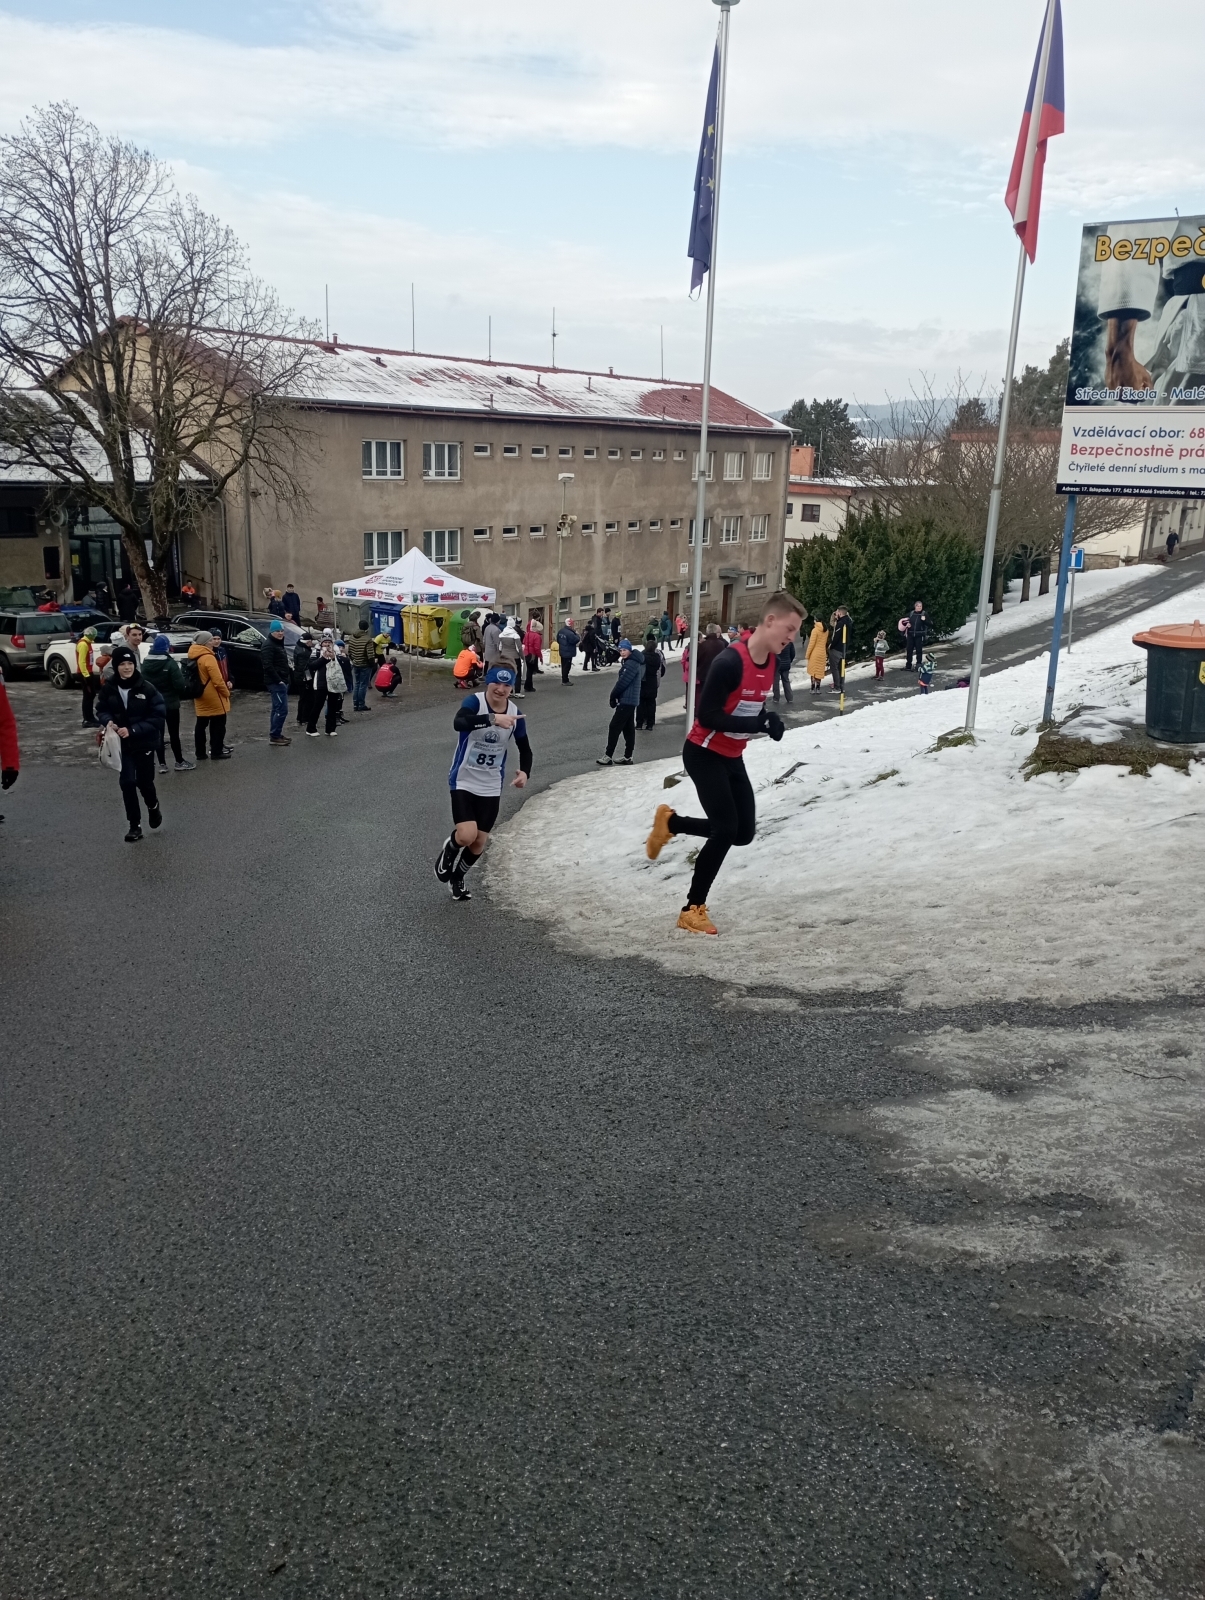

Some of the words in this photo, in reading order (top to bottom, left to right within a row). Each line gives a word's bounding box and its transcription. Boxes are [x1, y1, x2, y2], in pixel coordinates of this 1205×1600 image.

[1095, 227, 1205, 265] Bezpeč
[1075, 387, 1121, 400] Střední
[1122, 387, 1157, 400] škola
[1171, 386, 1205, 400] Malé
[1073, 425, 1147, 438] Vzdělávací
[1149, 427, 1185, 439] obor:
[1071, 443, 1174, 458] Bezpečnostně
[1179, 444, 1205, 460] prá
[1068, 461, 1106, 473] Čtyřleté
[1108, 463, 1137, 473] denní
[1139, 465, 1178, 474] studium
[476, 753, 497, 766] 83
